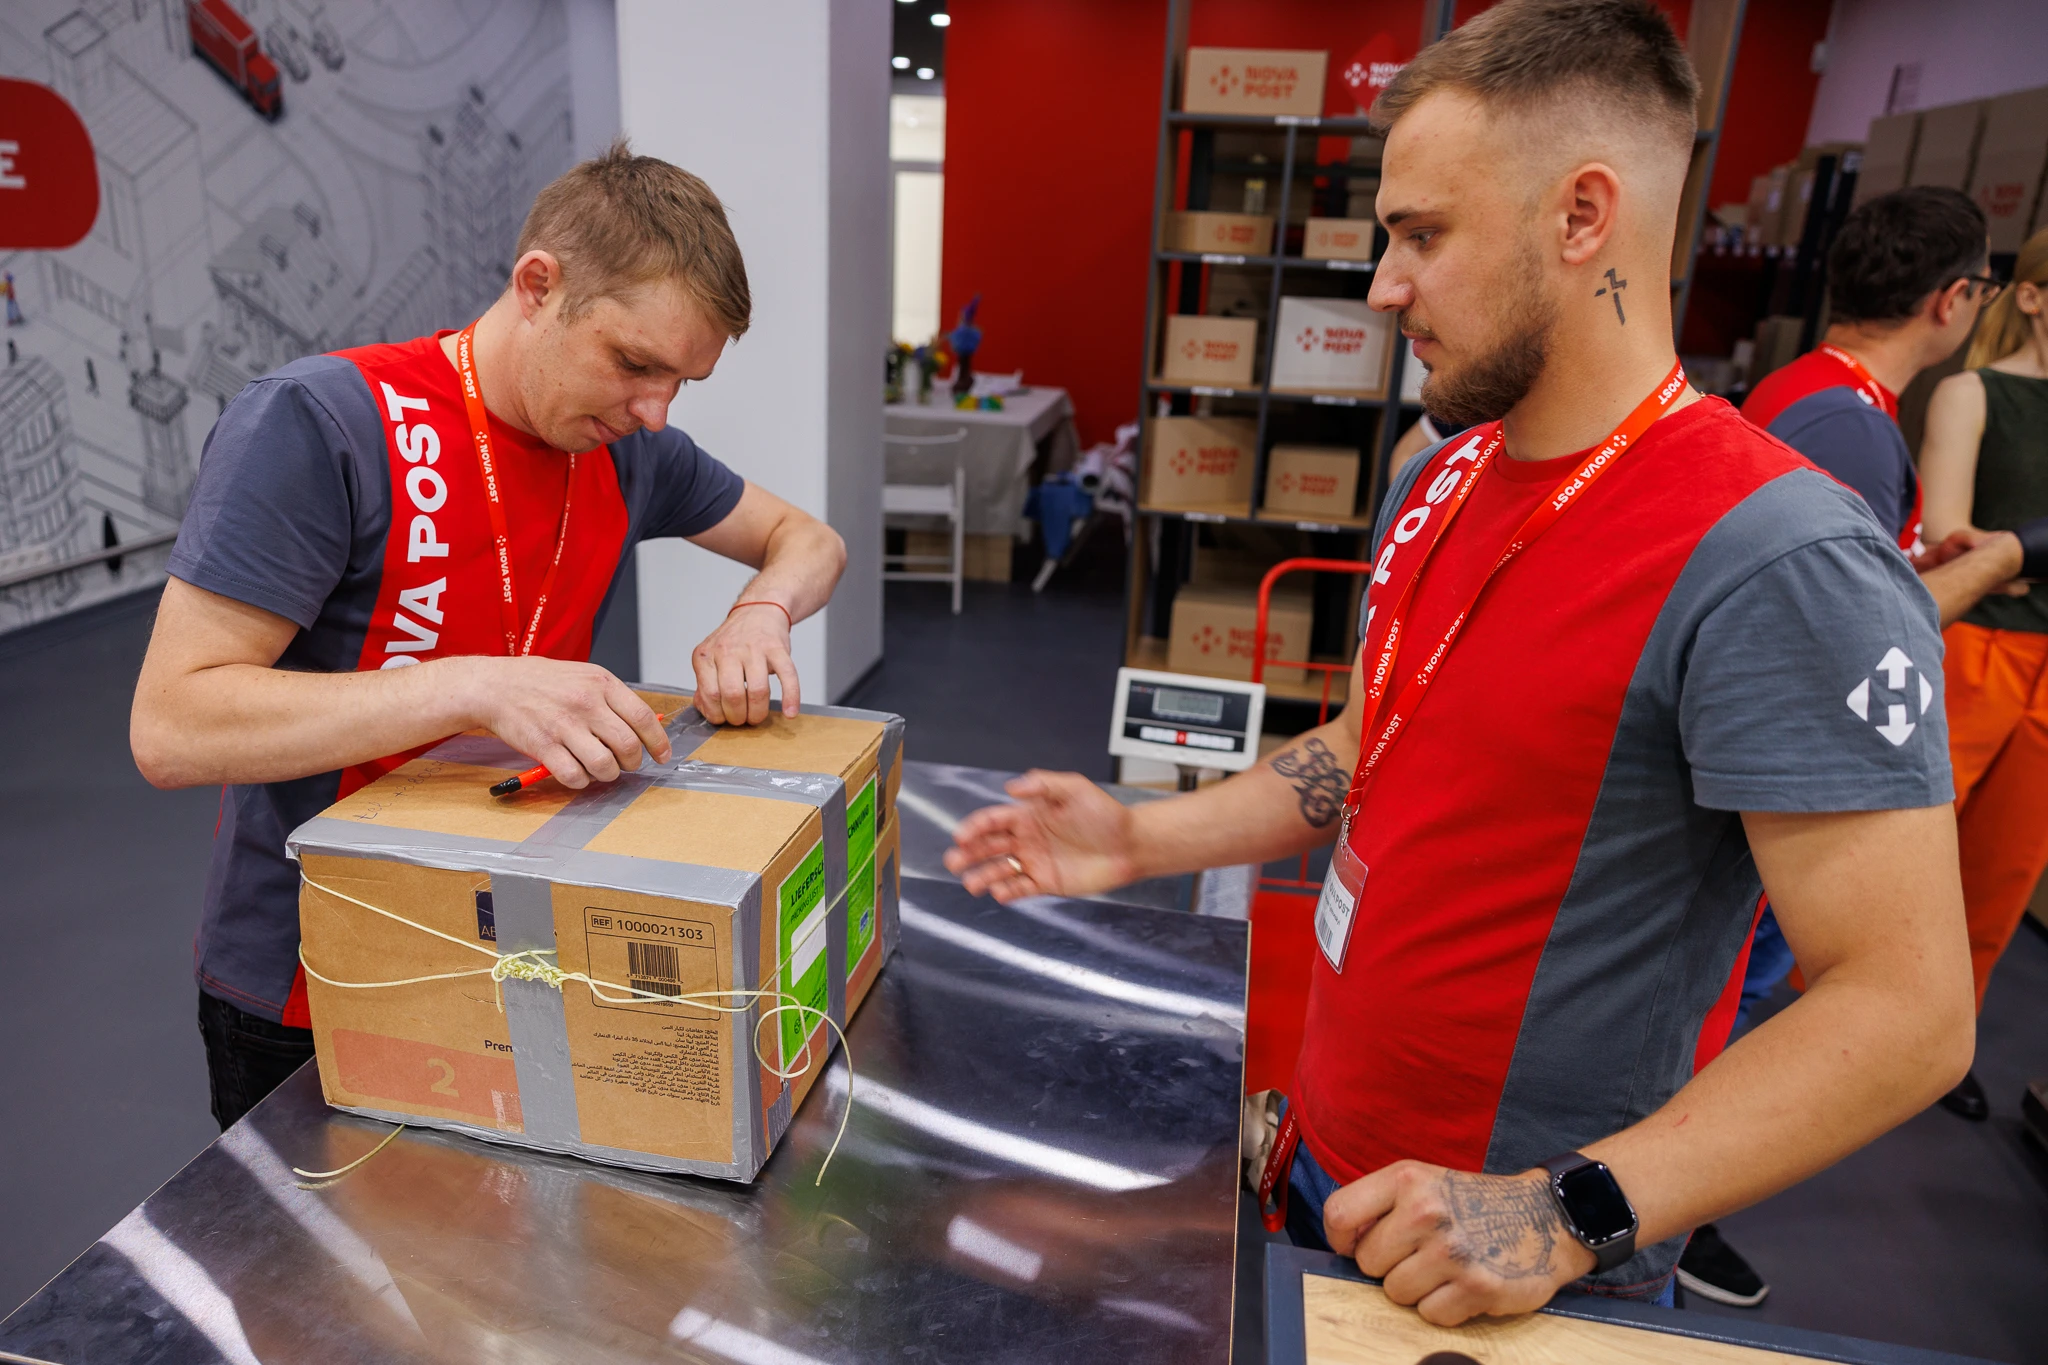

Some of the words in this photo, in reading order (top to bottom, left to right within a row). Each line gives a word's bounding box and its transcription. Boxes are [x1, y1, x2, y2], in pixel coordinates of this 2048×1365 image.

[1245, 66, 1298, 81] NOVA
[1368, 77, 1391, 88] PO
[1369, 62, 1405, 76] NO
[1244, 83, 1294, 99] POST
[460, 343, 470, 370] NOVA
[464, 371, 477, 399] POST
[1658, 378, 1681, 405] POST
[1474, 441, 1499, 469] NOVA
[1580, 446, 1616, 479] NOVA
[380, 381, 448, 563] POST
[480, 444, 492, 474] NOVA
[487, 475, 499, 503] POST
[1457, 470, 1478, 501] POST
[1552, 478, 1584, 511] POST
[1372, 435, 1483, 585] POST
[499, 547, 509, 576] NOVA
[503, 577, 512, 603] POST
[530, 606, 543, 632] NOVA
[521, 634, 534, 656] POST
[1229, 627, 1284, 646] NOA
[1424, 643, 1446, 674] NOVA
[1444, 612, 1465, 642] POST
[1228, 643, 1279, 659] POT
[1374, 652, 1391, 685] NOVA
[1385, 618, 1401, 651] POST
[1366, 740, 1388, 768] NOVA
[1382, 714, 1403, 741] POST
[593, 917, 610, 927] REF
[617, 919, 703, 940] 1000021303
[427, 1057, 460, 1098] 2
